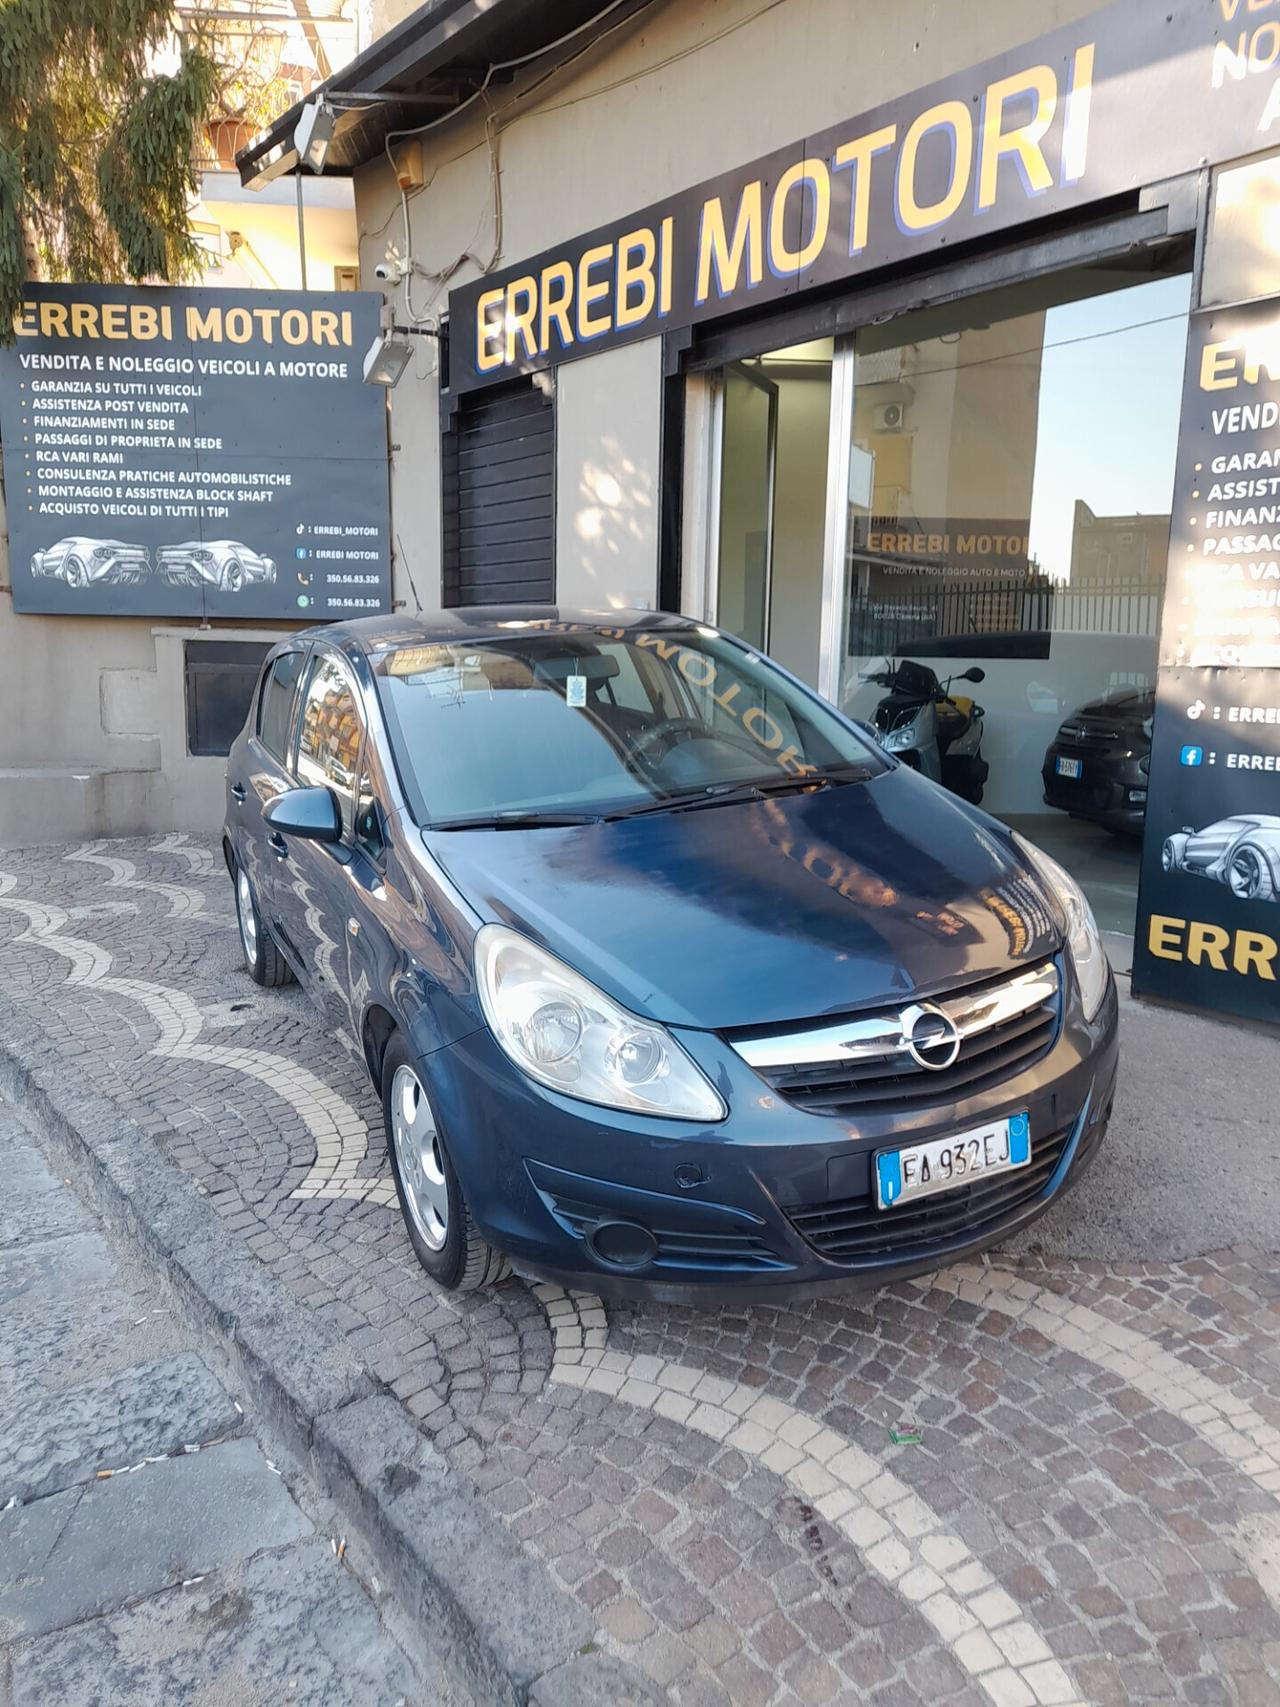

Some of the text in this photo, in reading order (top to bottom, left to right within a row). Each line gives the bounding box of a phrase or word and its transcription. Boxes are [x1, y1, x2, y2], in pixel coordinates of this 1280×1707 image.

[474, 43, 1096, 375] ERREBI MOTORI
[13, 302, 352, 346] ERREBI MOTORI
[20, 354, 348, 378] VENDITA E NOLEGGIO VEICOLI A MOTORE
[31, 381, 92, 393] GARANZIA
[95, 382, 110, 393] SU
[113, 383, 147, 395] TUTTI
[156, 385, 202, 397] VEICOLI
[32, 398, 189, 414] ASSISTENZA POST VENDITA
[34, 415, 175, 431] FINANZIAMENTI IN SEDE
[1212, 402, 1280, 435] VEND
[35, 433, 222, 449] PASSAGGI DI PROPRIETA IN SEDE
[36, 451, 123, 464] RCA VARI RAMI
[37, 467, 291, 485] CONSULENZA PRATICHE AUTOMOBILISTICHE
[38, 485, 273, 502] MONTAGGIO E ASSISTENZA BLOCK SHAFT
[39, 502, 99, 516] ACQUISTO
[102, 504, 146, 516] VEICOLI
[150, 505, 162, 516] DI
[165, 506, 197, 517] TUTTI
[207, 507, 229, 518] TIPI
[1205, 505, 1280, 529] FINAN
[313, 525, 378, 536] ERREBI_MOTORI
[867, 532, 950, 555] ERREBI
[316, 549, 344, 559] ERREBI
[346, 551, 379, 560] MOTORI
[970, 568, 993, 577] AUTO
[1000, 568, 1026, 577] MOTO
[1149, 914, 1277, 981] ERR
